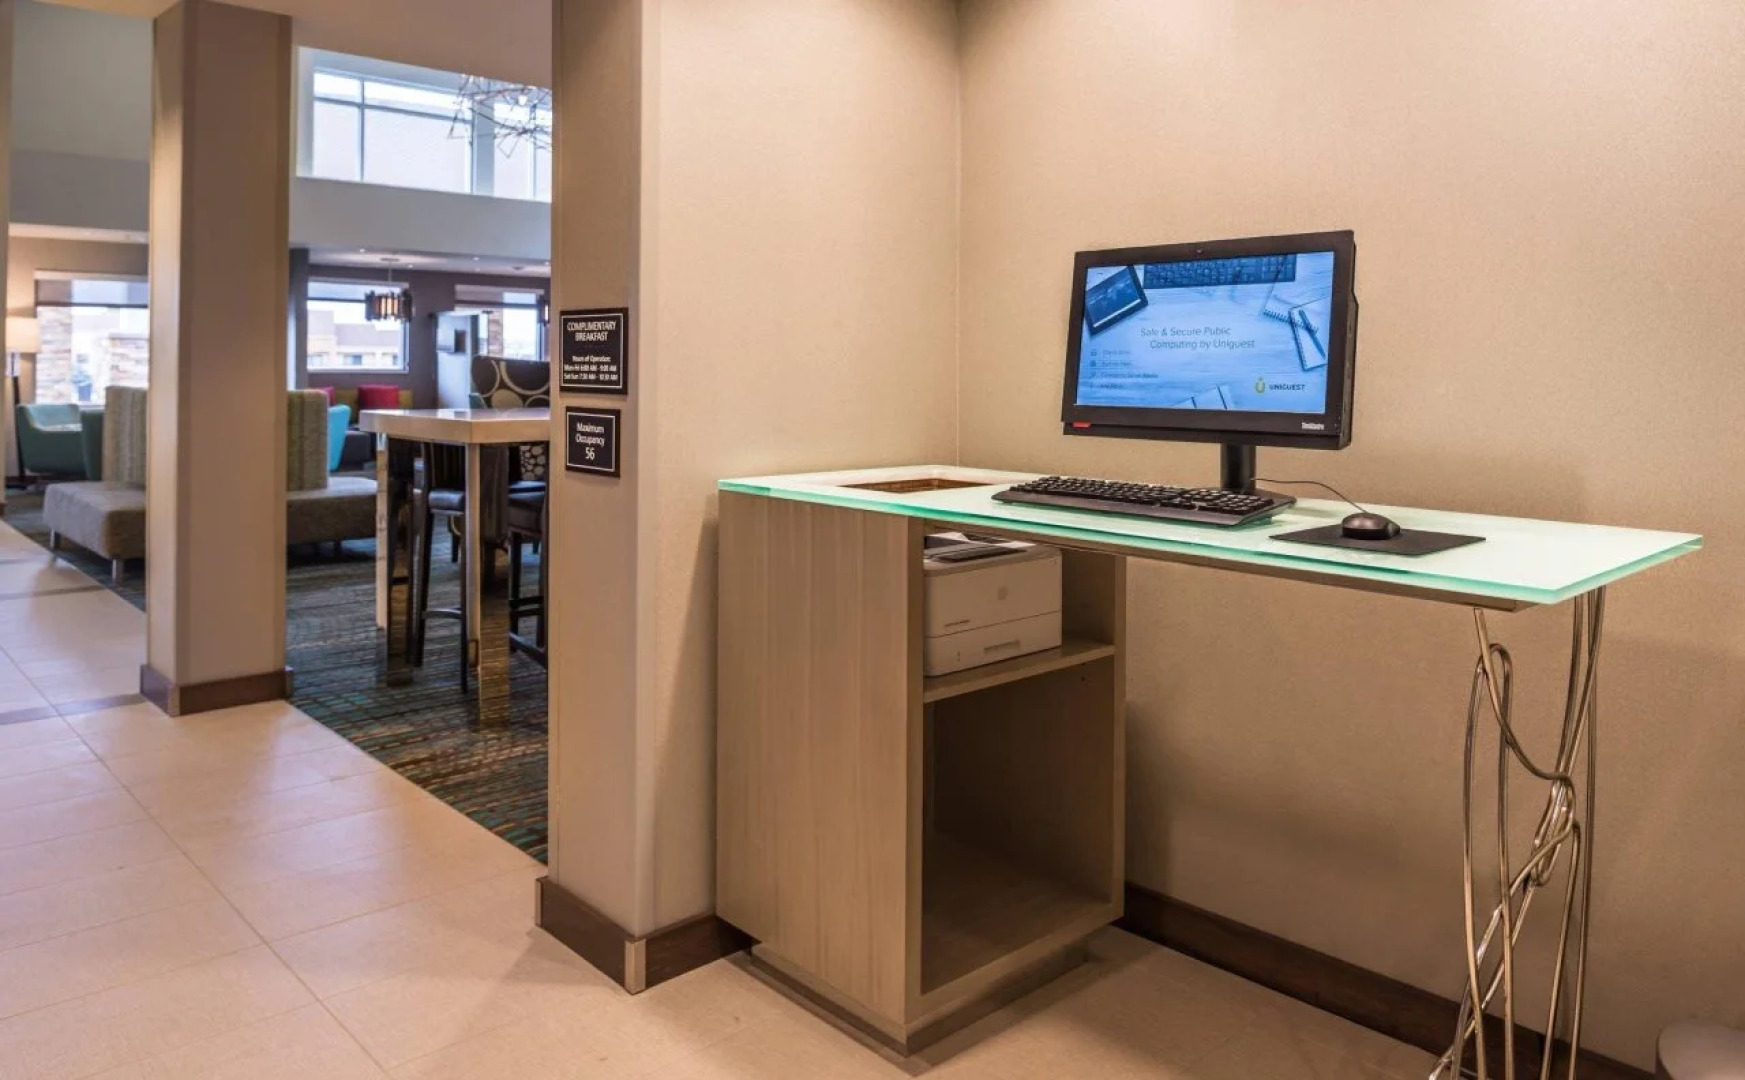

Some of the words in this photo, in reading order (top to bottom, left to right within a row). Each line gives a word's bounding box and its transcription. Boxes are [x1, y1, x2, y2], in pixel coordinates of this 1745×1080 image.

[566, 321, 616, 331] COMPLIMENTARY
[1140, 327, 1159, 337] Safe
[1161, 327, 1168, 336] &
[1170, 326, 1201, 336] Secure
[1203, 326, 1232, 335] Public
[575, 331, 608, 341] BREAKFAST
[1150, 339, 1198, 351] Computing
[1200, 339, 1211, 349] by
[1213, 338, 1255, 349] Uniguest
[1268, 383, 1306, 391] UNIGUEST
[576, 422, 605, 434] Maximum
[575, 433, 605, 447] Occupancy
[585, 446, 595, 460] 56
